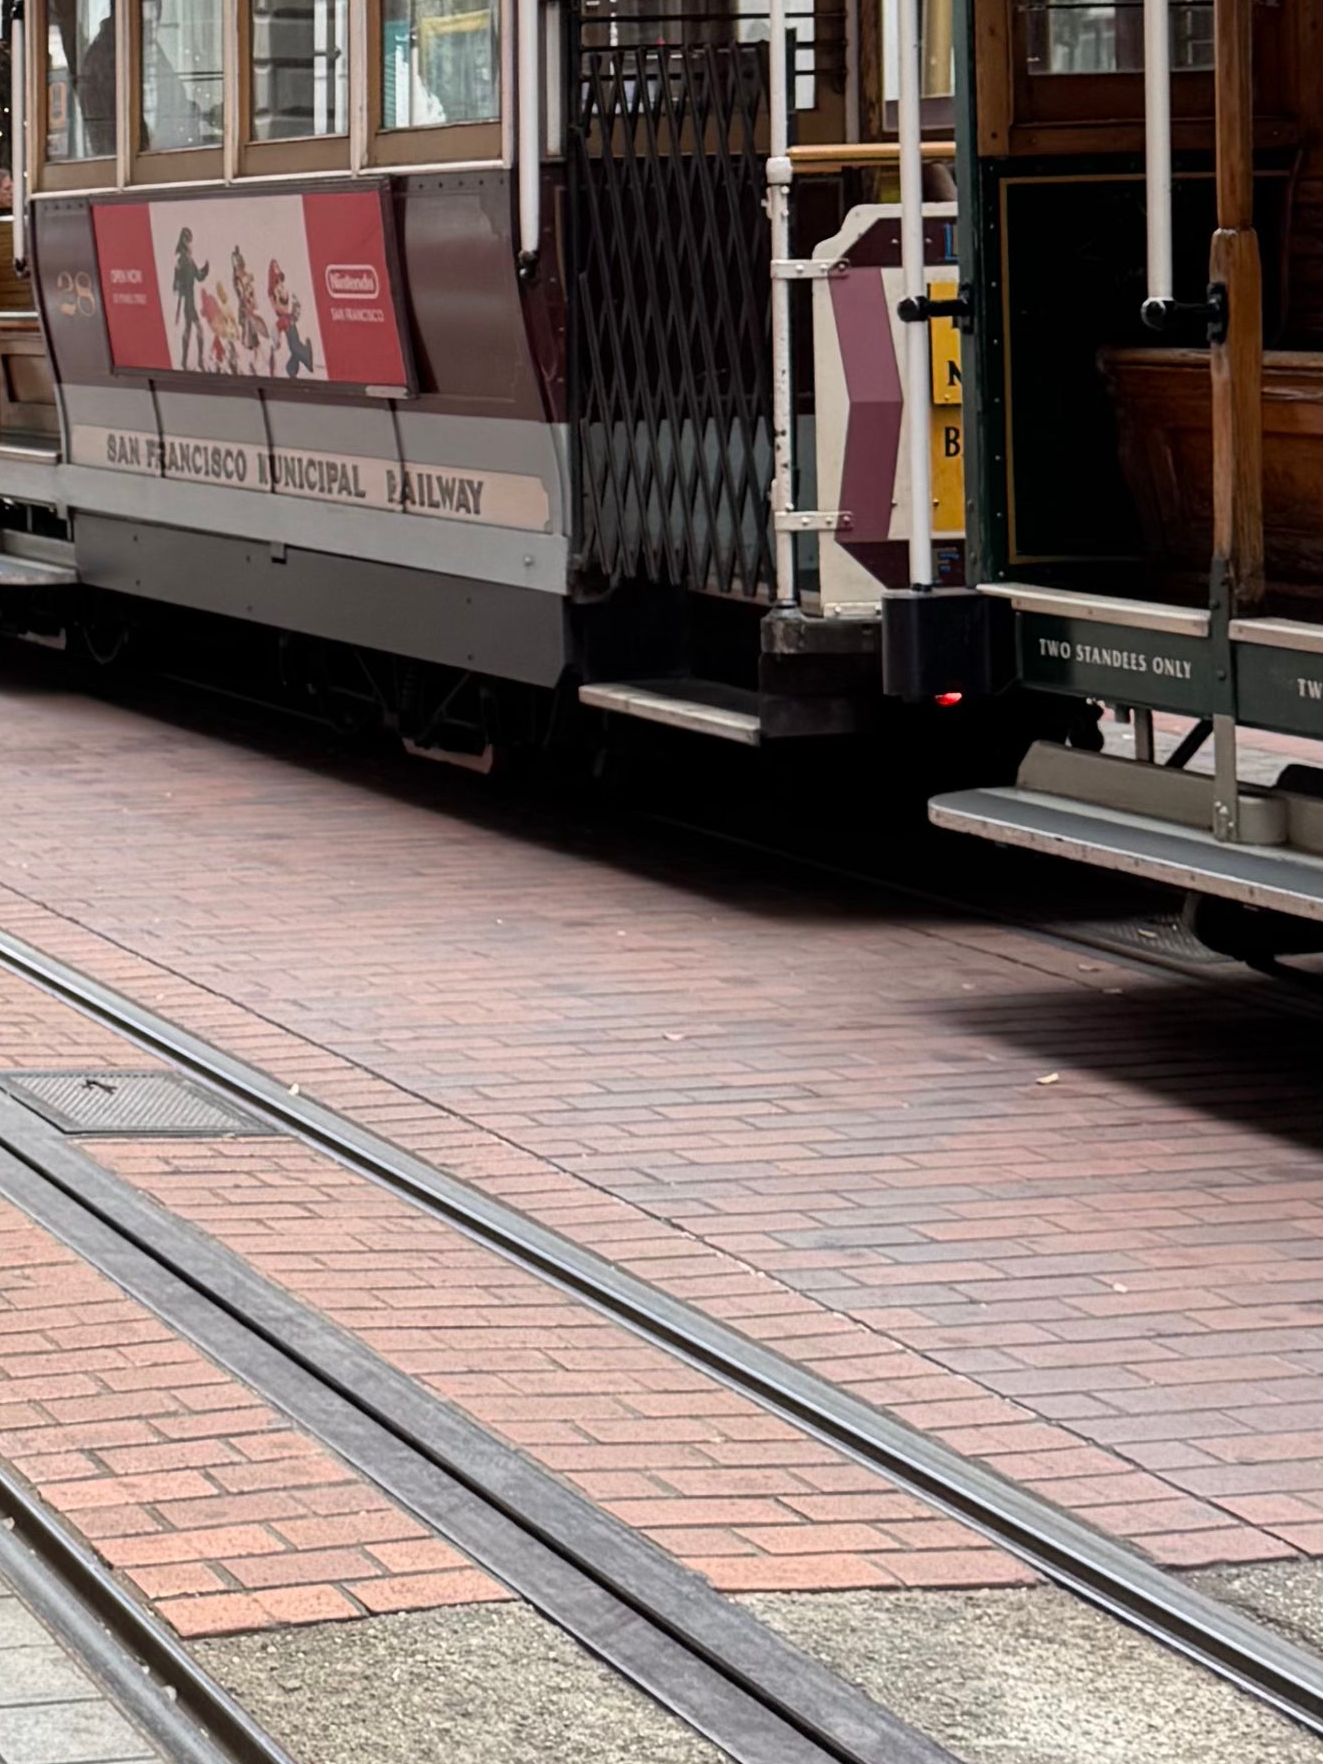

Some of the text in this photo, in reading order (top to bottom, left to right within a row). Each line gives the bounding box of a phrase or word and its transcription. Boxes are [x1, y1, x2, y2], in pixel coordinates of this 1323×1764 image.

[57, 271, 96, 317] 28
[329, 272, 375, 291] Nintendo
[107, 433, 140, 467] SAN
[1039, 638, 1191, 680] TWO STANDEES ONLY
